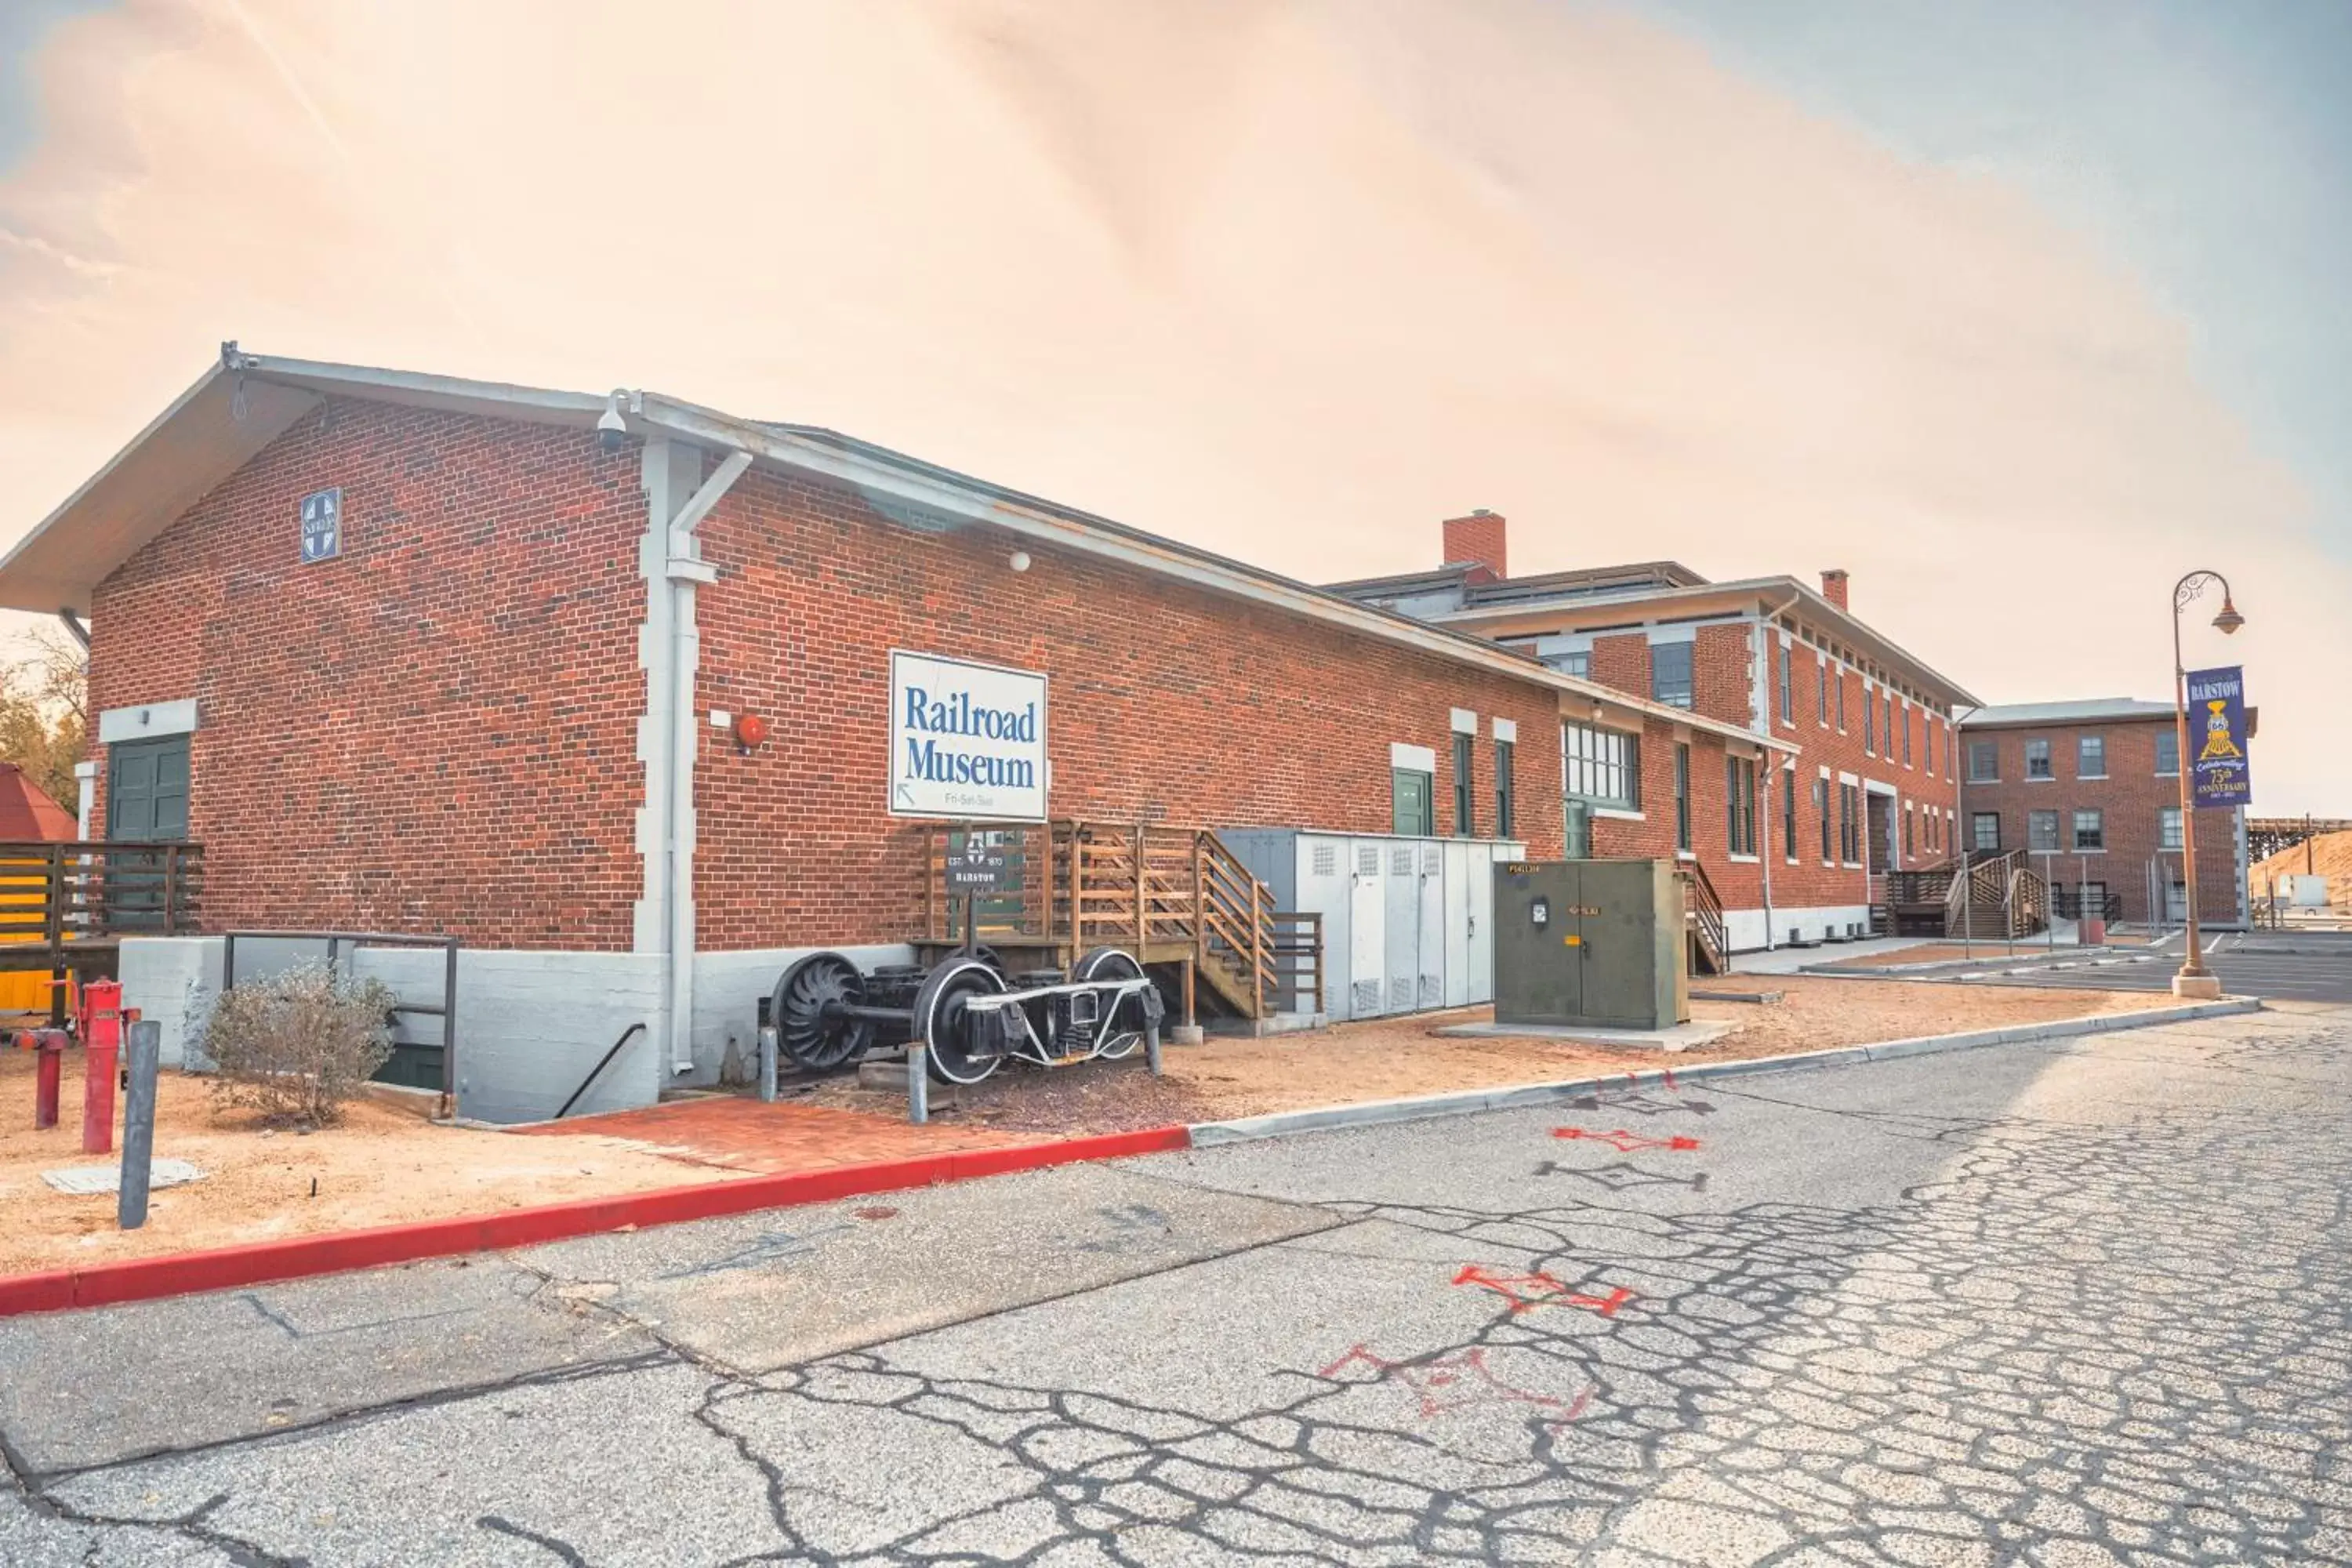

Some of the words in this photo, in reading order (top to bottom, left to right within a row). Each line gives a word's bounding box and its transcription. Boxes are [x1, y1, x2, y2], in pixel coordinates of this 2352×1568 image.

[2191, 681, 2240, 700] BARSTOW
[905, 687, 1036, 743] Railroad
[905, 737, 1034, 789] Museum
[2210, 768, 2232, 783] 75th
[956, 873, 995, 882] BARSTOW
